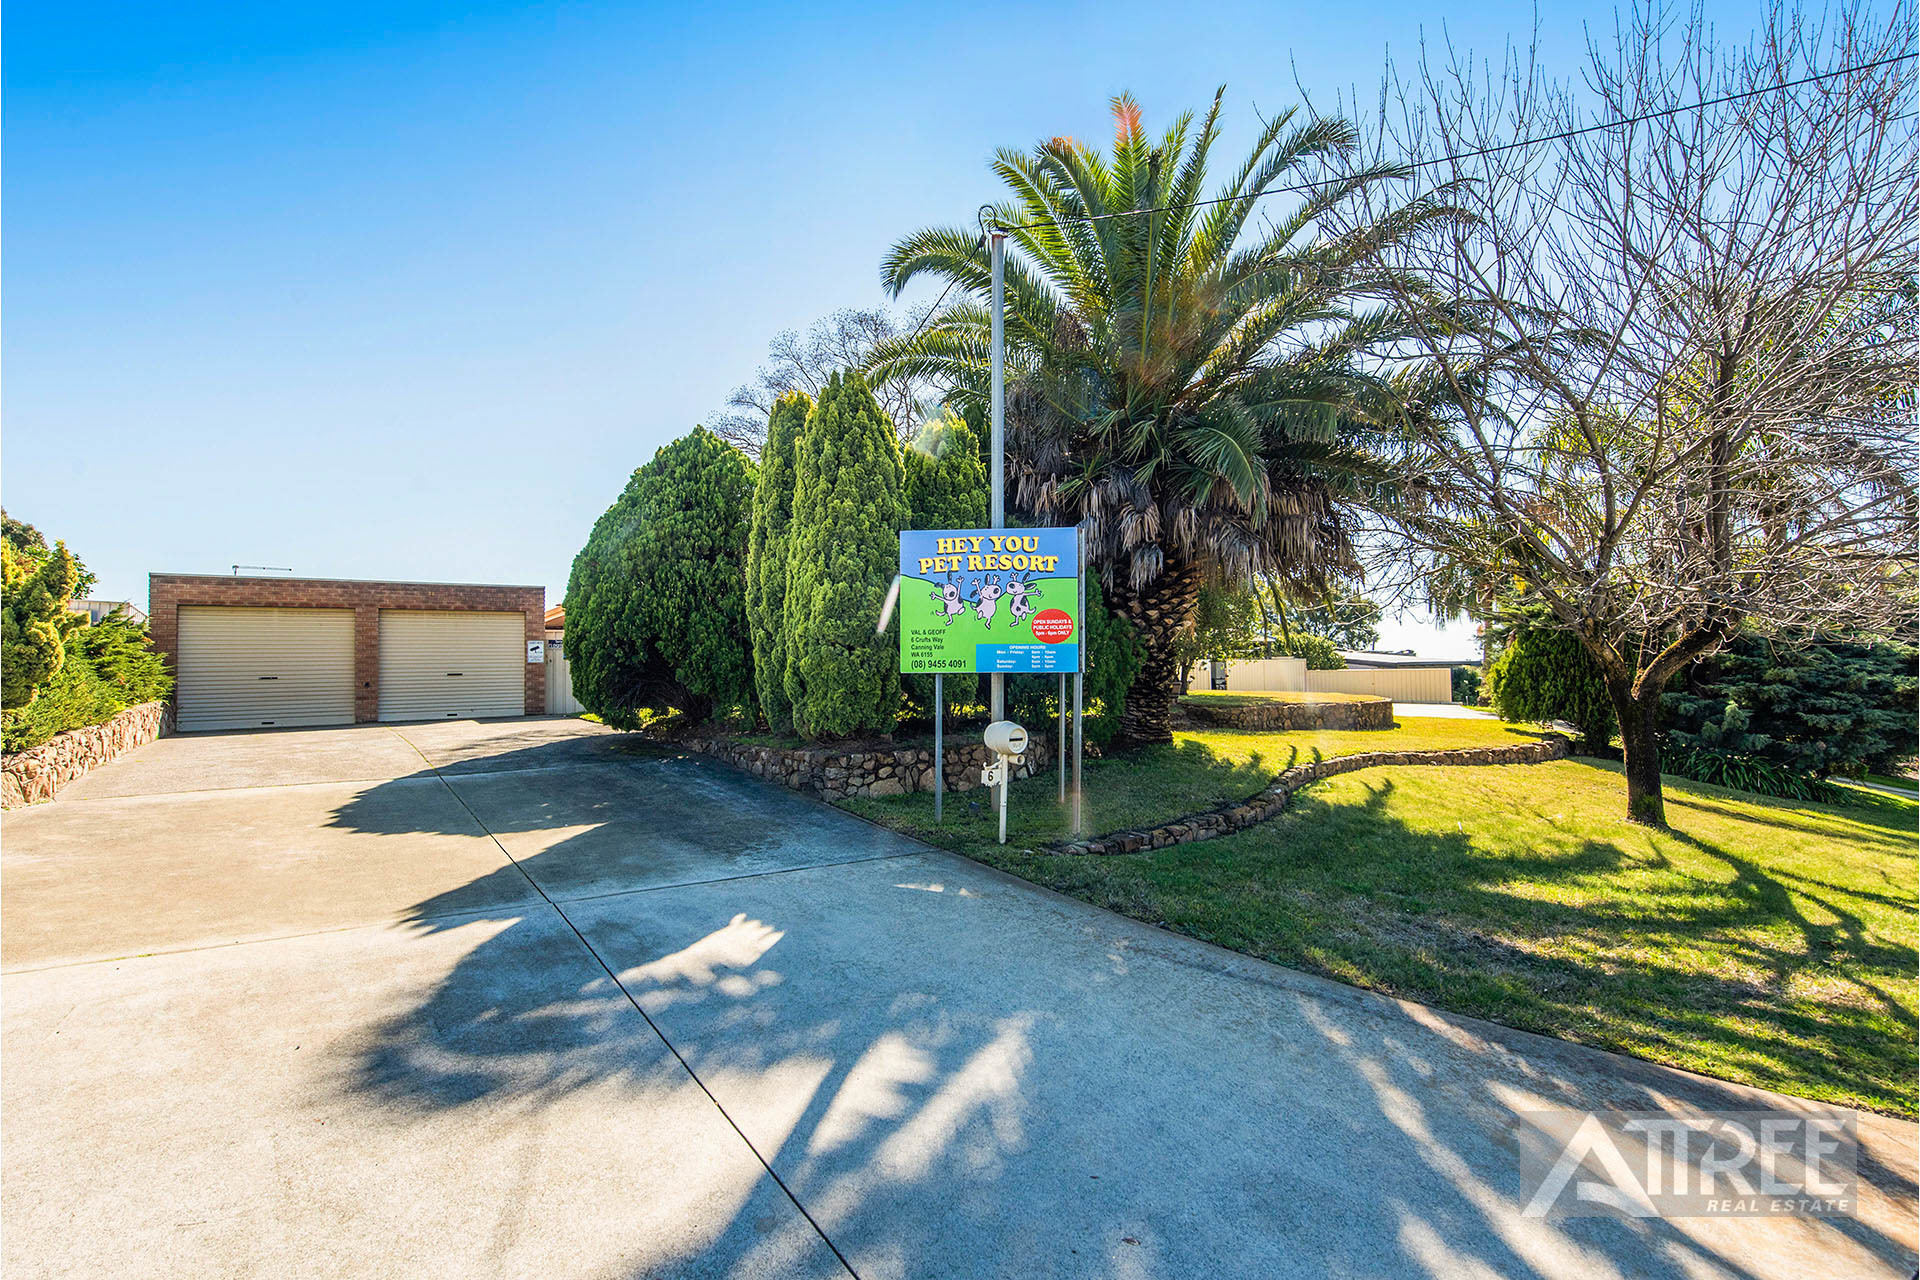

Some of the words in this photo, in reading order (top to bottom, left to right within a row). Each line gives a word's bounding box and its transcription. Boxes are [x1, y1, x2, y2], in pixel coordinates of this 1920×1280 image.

[936, 536, 984, 554] HEY
[989, 535, 1039, 552] YOU
[918, 556, 962, 574] PET
[967, 554, 1058, 572] RESORT
[911, 660, 926, 670] (08)
[928, 660, 947, 668] 9455
[948, 660, 967, 668] 4091
[988, 770, 994, 782] 6
